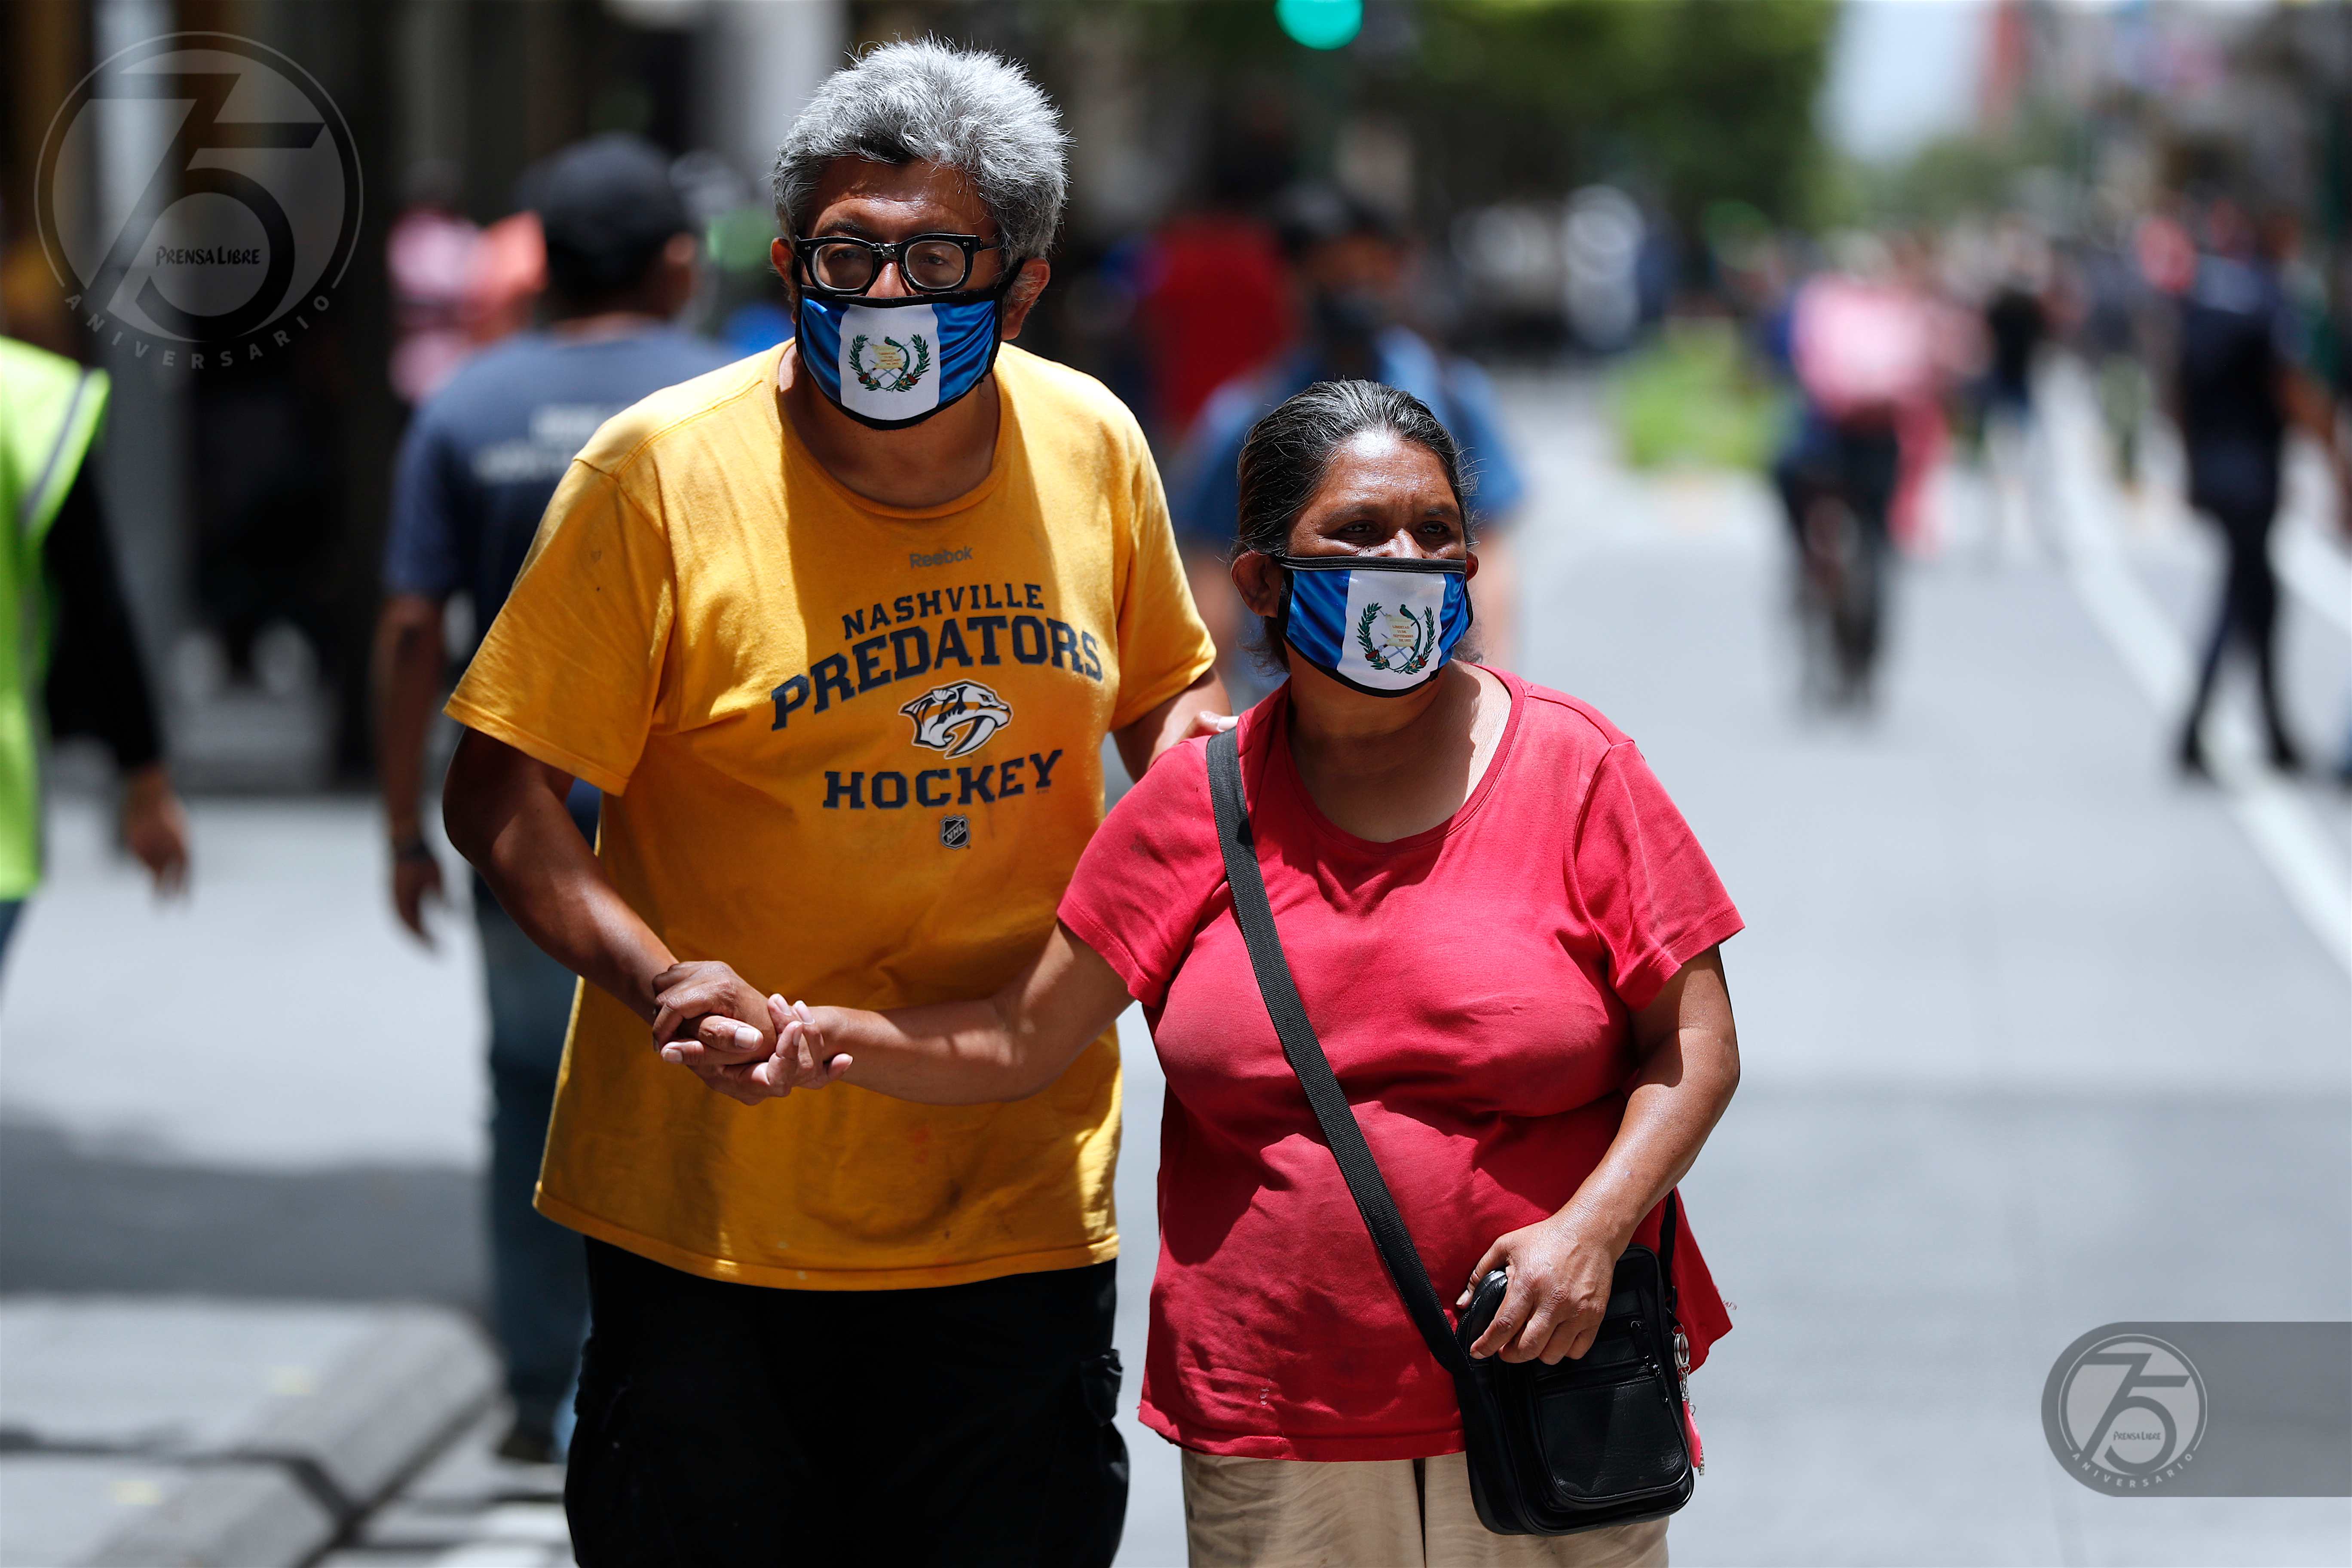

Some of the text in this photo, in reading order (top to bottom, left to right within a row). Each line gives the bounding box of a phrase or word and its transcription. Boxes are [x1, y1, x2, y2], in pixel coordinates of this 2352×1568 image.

[910, 546, 973, 569] Reebok
[842, 583, 1044, 640] NASHVILLE
[771, 615, 1103, 731] PREDATORS
[823, 750, 1062, 809] HOCKEY
[947, 824, 964, 842] NHL
